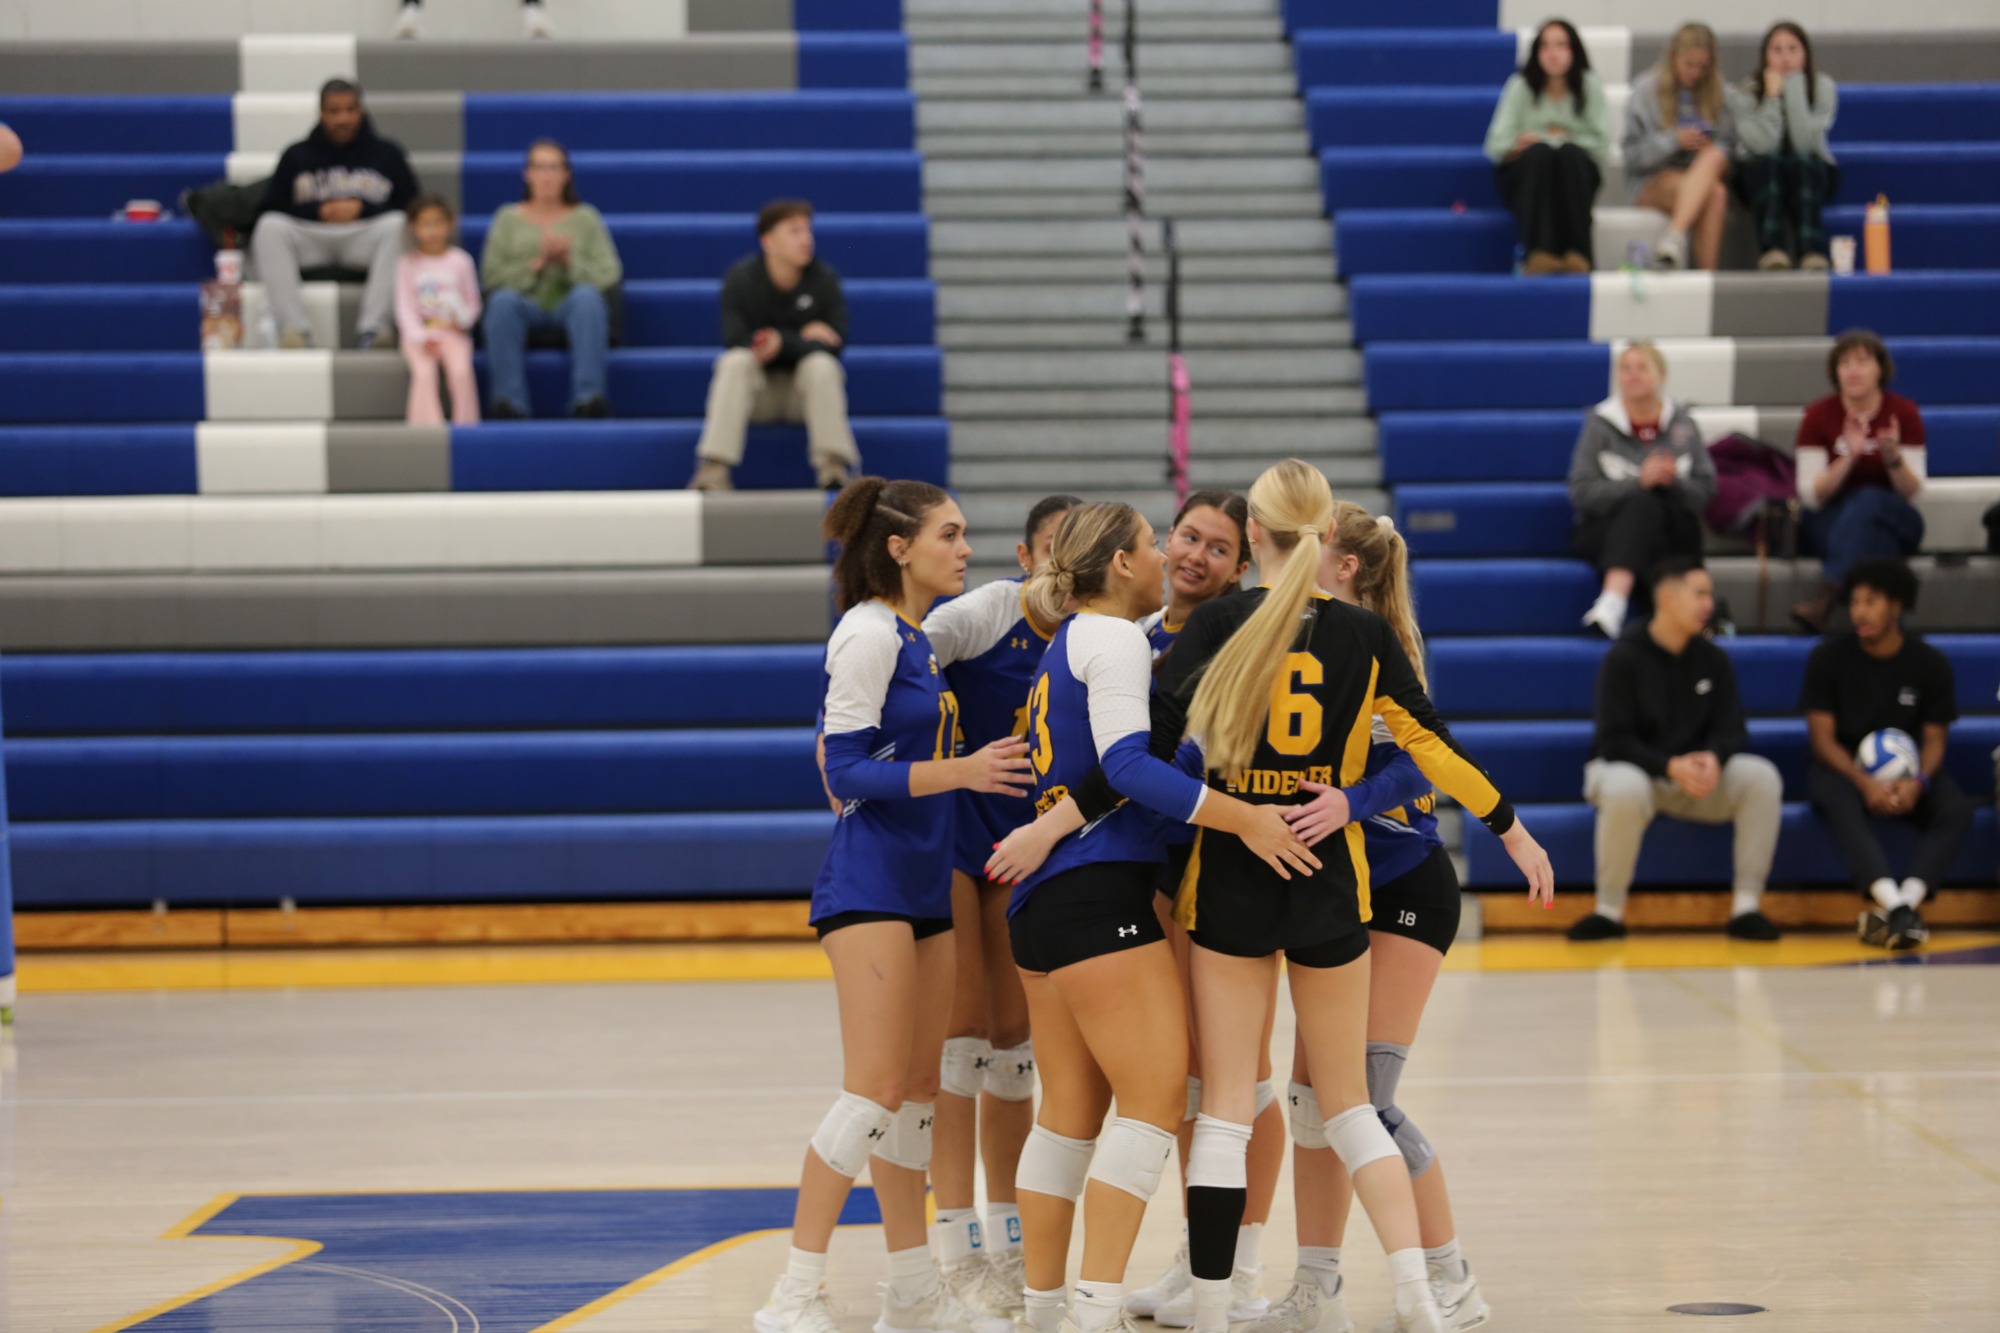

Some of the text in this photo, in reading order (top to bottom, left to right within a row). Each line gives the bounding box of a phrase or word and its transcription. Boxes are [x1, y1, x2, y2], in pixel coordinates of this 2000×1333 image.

[1027, 671, 1054, 785] 3
[1267, 650, 1324, 756] 6
[1397, 910, 1417, 927] 18
